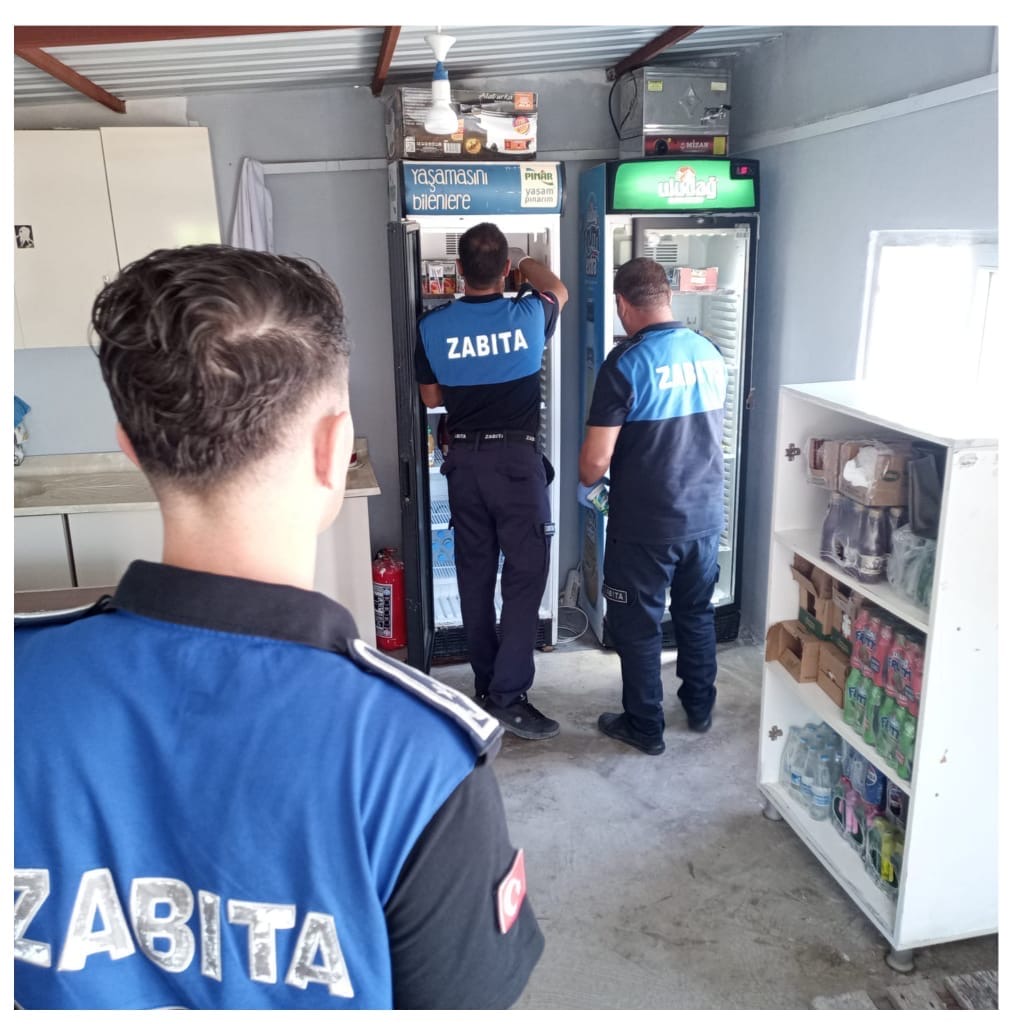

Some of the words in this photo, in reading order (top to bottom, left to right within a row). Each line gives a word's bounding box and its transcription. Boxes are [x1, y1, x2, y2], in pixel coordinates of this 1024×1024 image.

[412, 193, 471, 212] bilenlere
[446, 328, 528, 360] ZABITA
[13, 866, 354, 999] ZABITA
